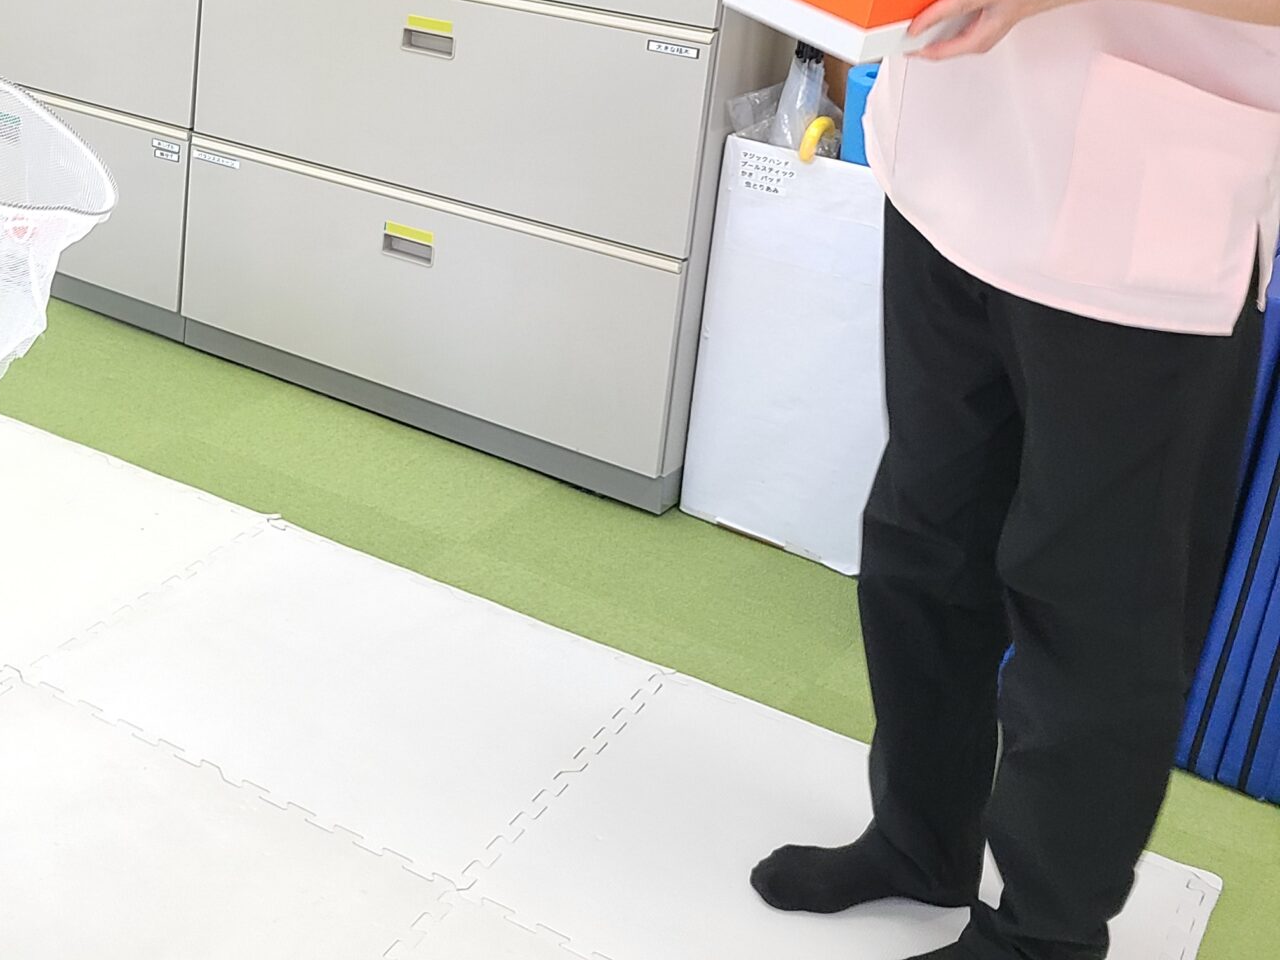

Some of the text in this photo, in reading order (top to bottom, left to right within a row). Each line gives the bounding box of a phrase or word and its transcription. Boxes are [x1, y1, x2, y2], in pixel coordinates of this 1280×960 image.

[742, 151, 790, 166] マジックハンド
[741, 160, 795, 178] プールスティック
[744, 181, 780, 194] 虫とりあみ
